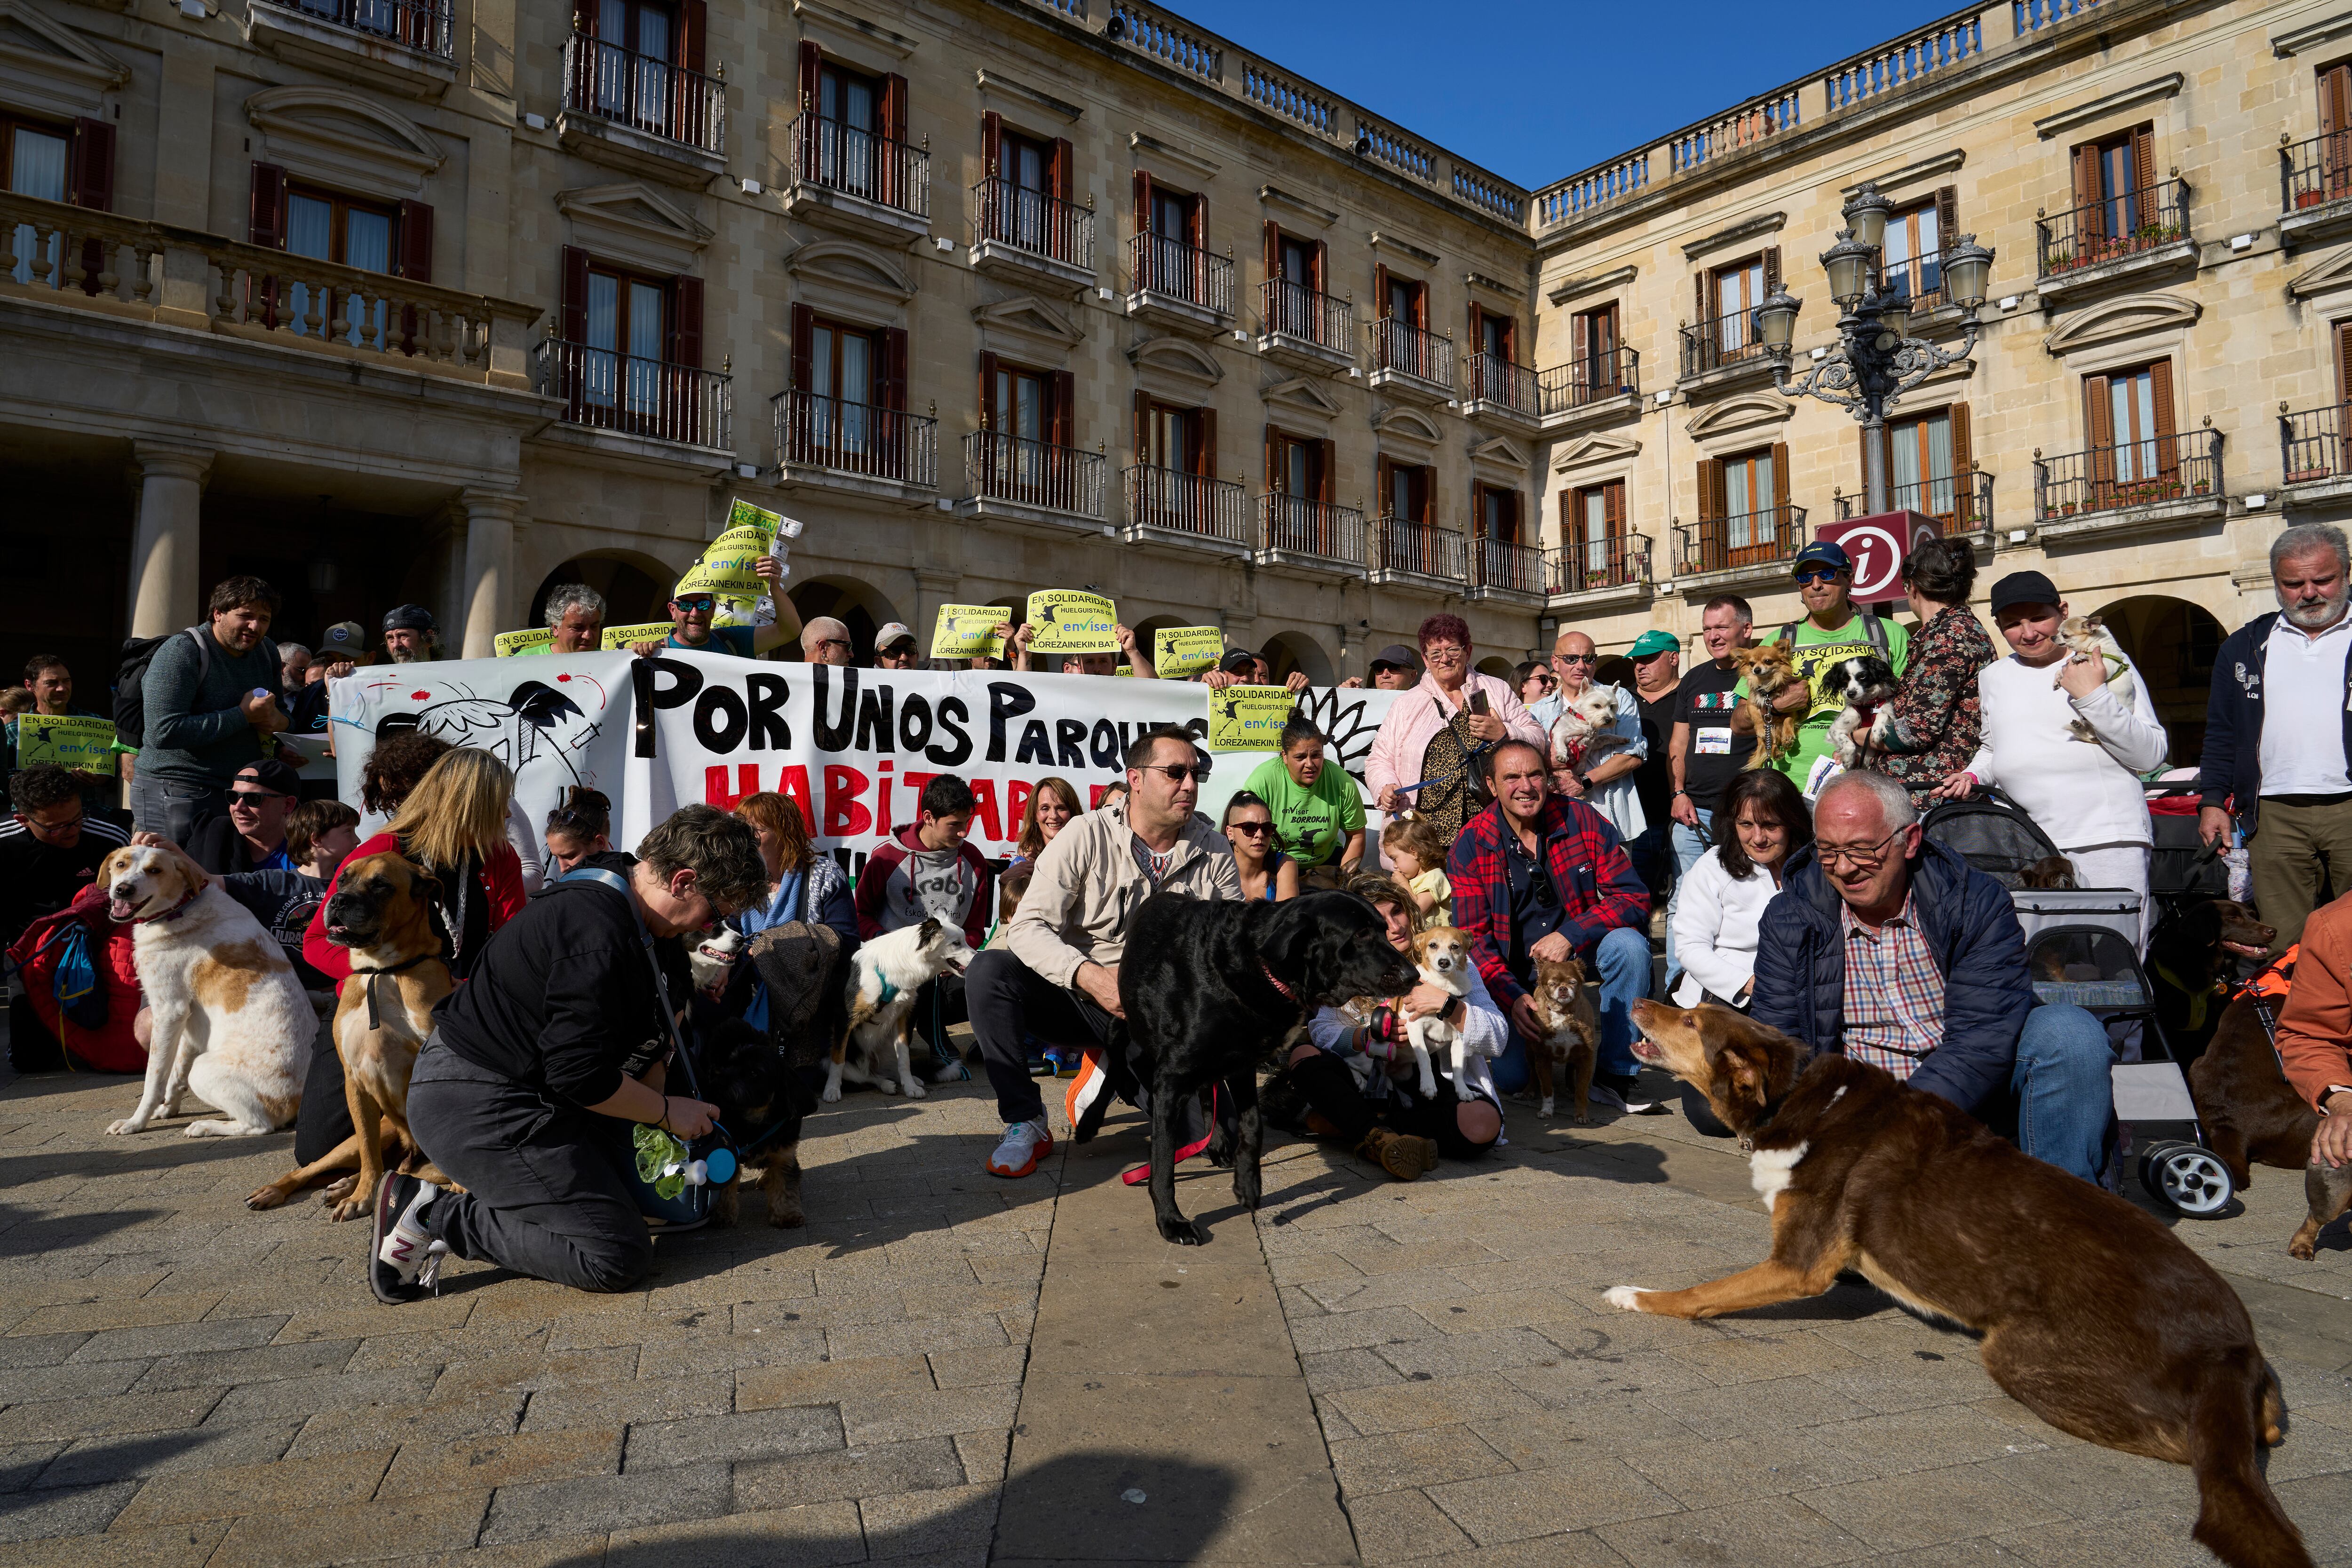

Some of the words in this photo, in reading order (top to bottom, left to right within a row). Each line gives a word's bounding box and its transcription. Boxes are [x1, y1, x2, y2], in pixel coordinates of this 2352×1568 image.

[707, 531, 767, 550] OLIDARIDAD
[711, 545, 756, 554] HUELGUISTAS
[711, 552, 757, 571] envise
[681, 579, 744, 591] LOREZAINEKIN
[1033, 595, 1044, 604] EN
[1048, 594, 1112, 609] SOLIDARIDAD
[498, 637, 510, 646] EN
[513, 632, 557, 644] SOLIDAR
[604, 631, 615, 640] EN
[619, 626, 671, 638] SOLIDARID
[961, 626, 1001, 640] envise
[1168, 630, 1219, 638] SOLIDARIDAD
[1160, 665, 1207, 675] LOREZAINEKIN
[1230, 689, 1293, 699] SOLIDARIDAD
[631, 658, 791, 758] POR
[812, 663, 973, 767] UNOS
[44, 718, 114, 731] SOLIDARIDAD
[1245, 712, 1286, 729] envise
[58, 730, 104, 739] HUELGUISTAS
[274, 896, 300, 923] WELCOME
[905, 907, 929, 918] Eskola
[275, 929, 303, 943] JURA
